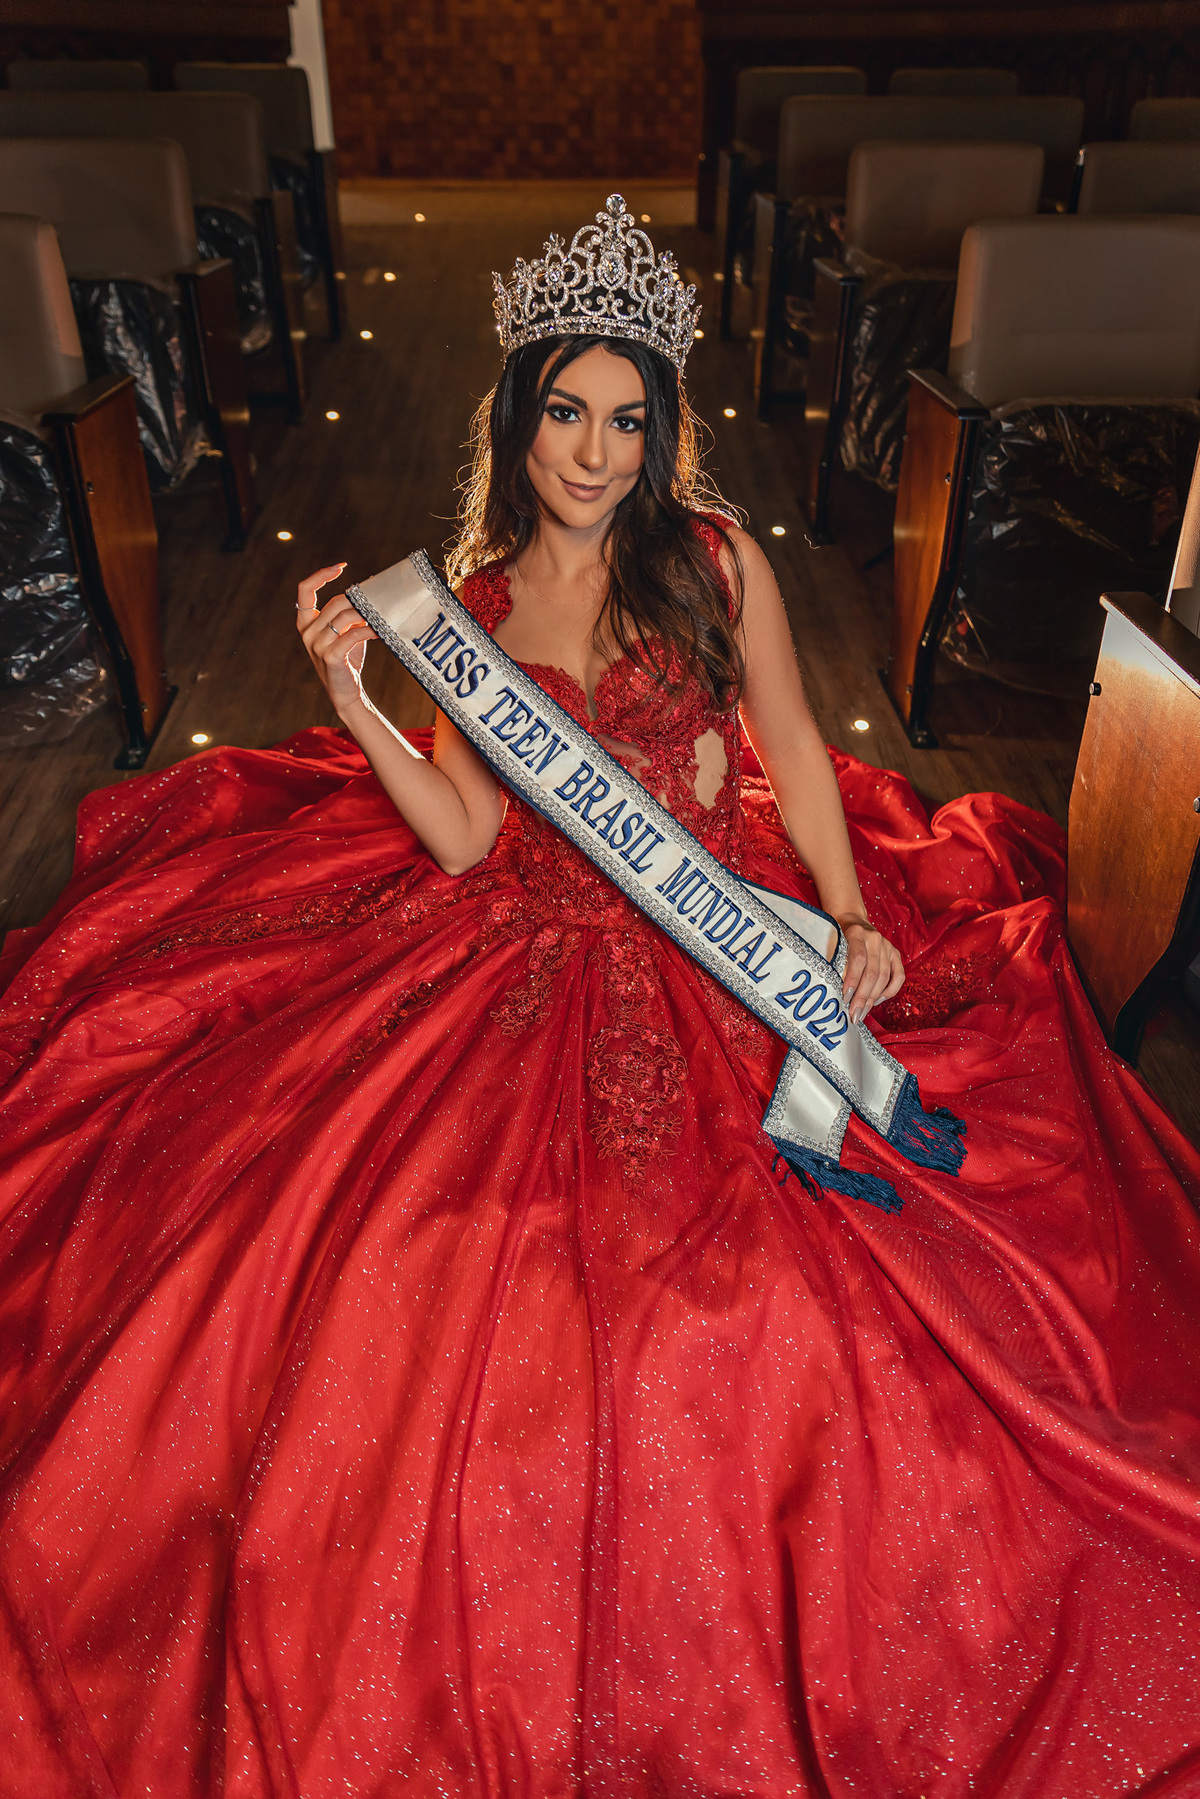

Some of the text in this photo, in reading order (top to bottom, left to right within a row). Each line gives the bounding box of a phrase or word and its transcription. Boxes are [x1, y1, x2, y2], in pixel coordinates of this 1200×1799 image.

[412, 612, 849, 1051] MISS TEEN BRASIL MUNDIAL 2022
